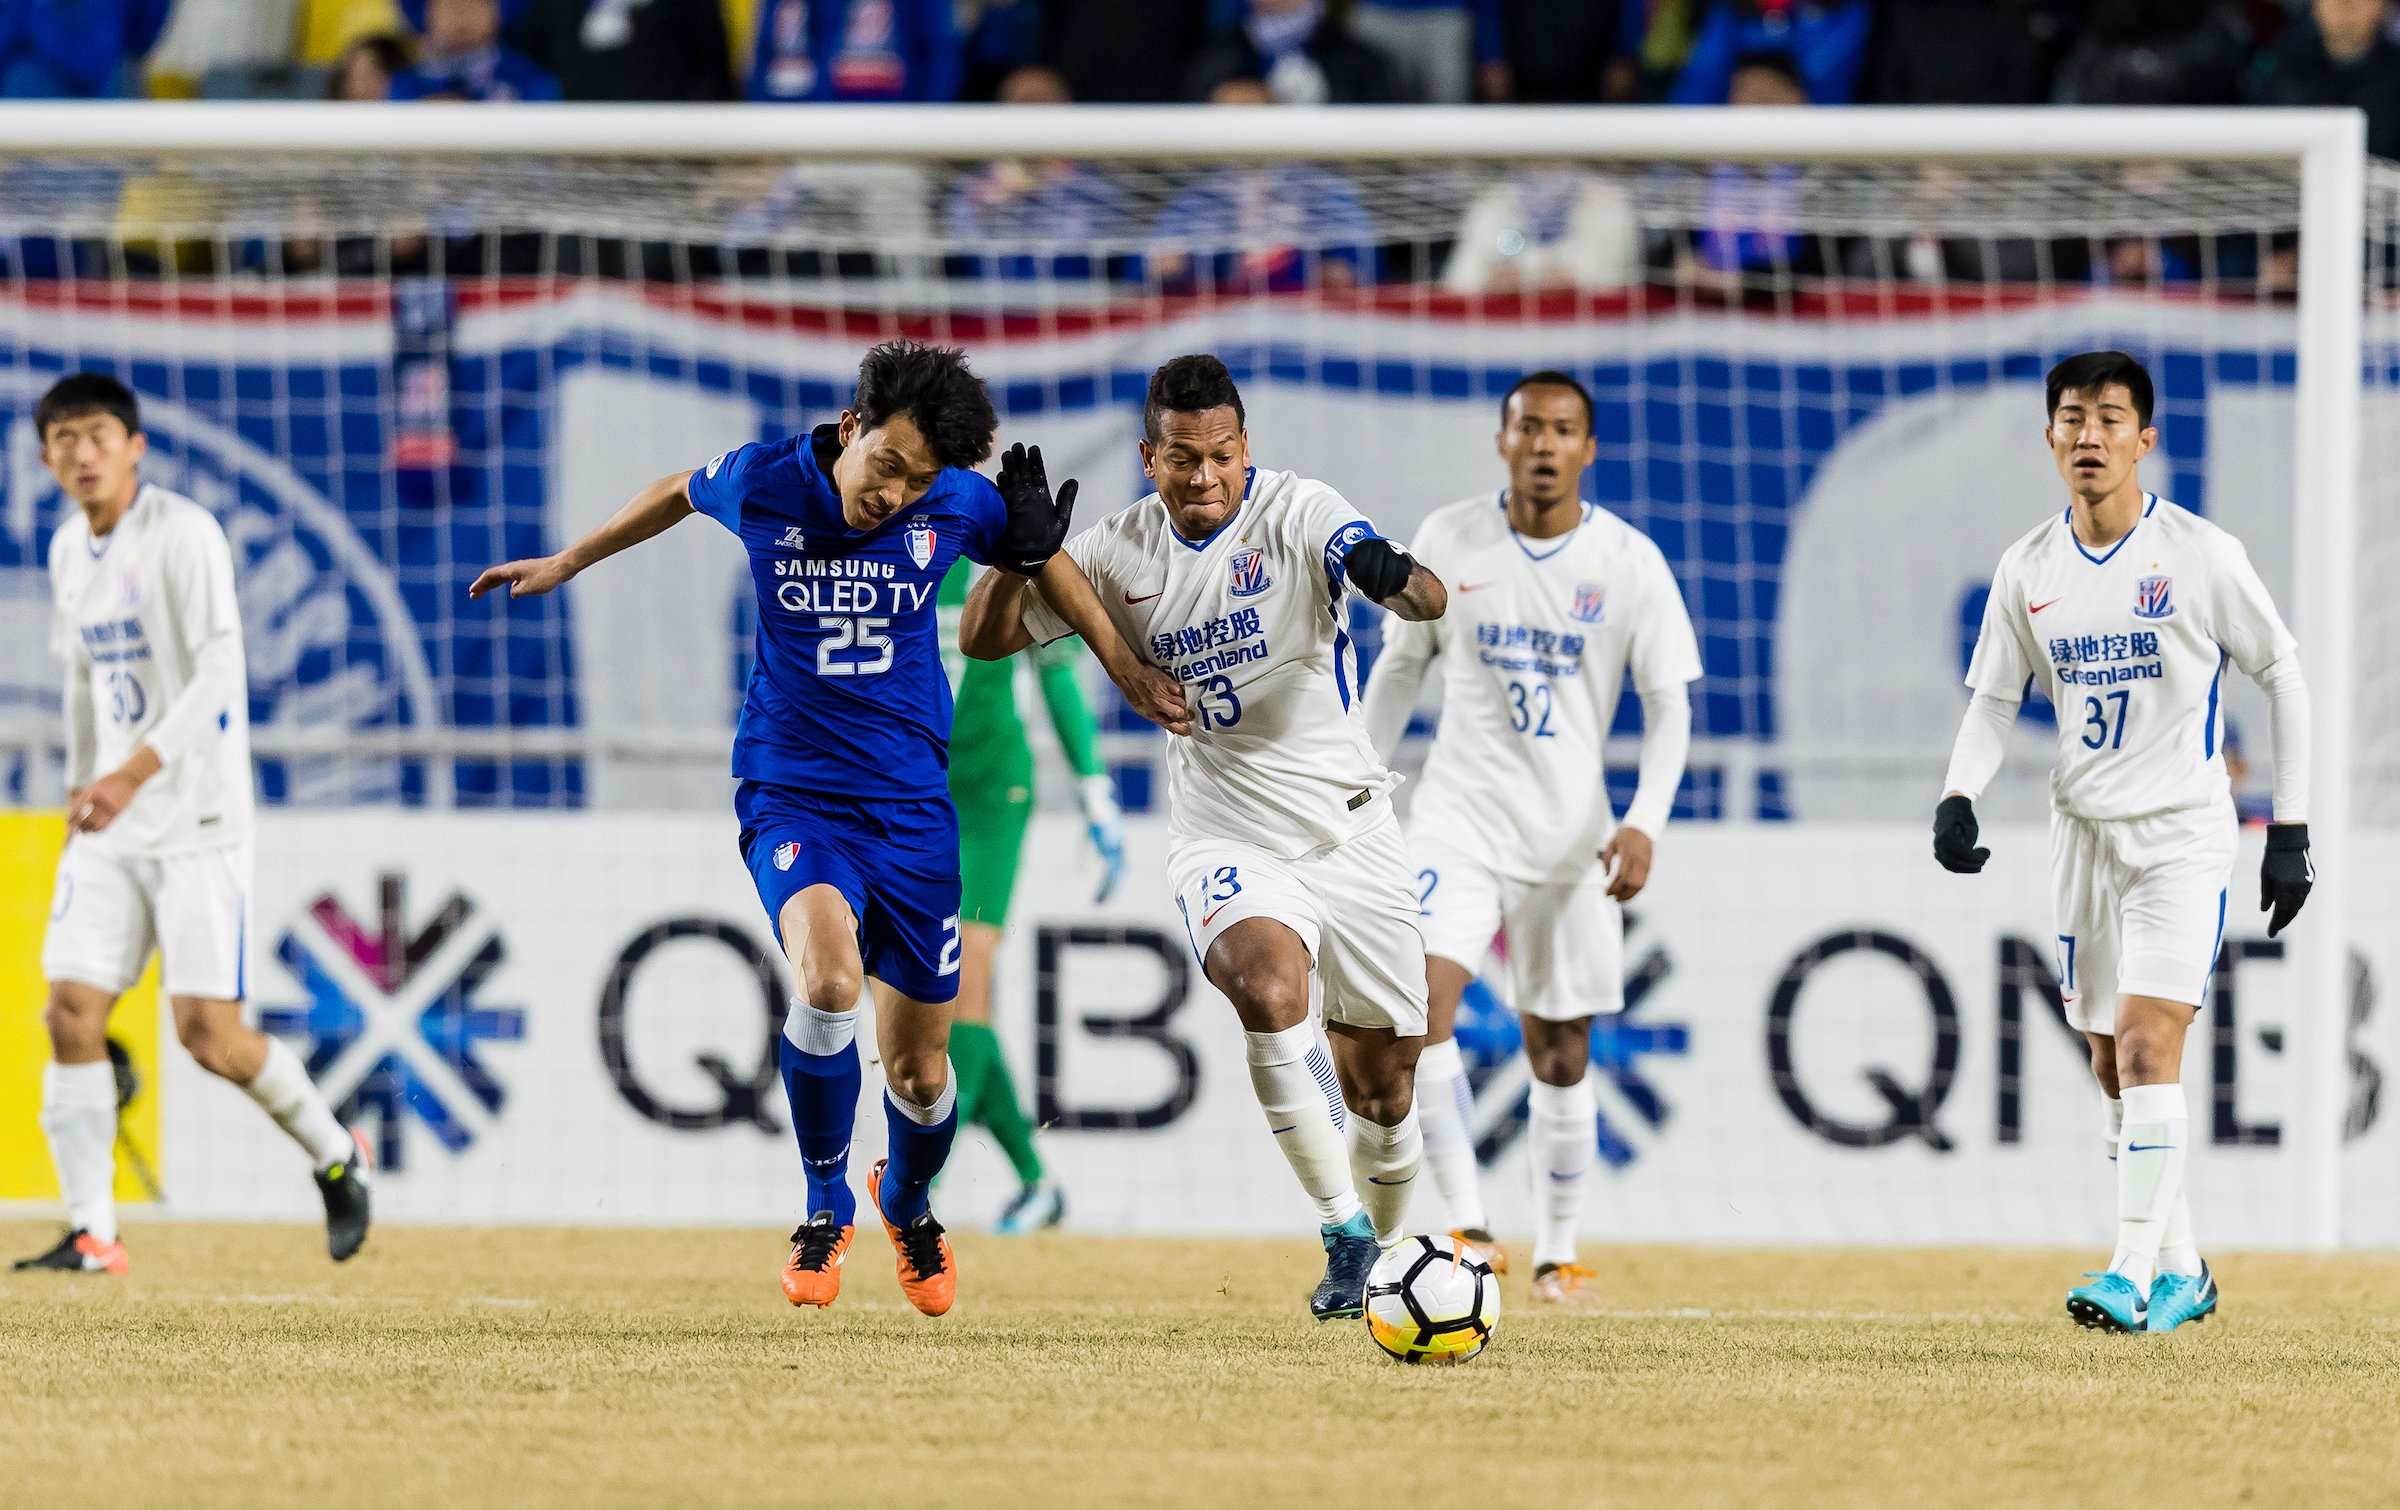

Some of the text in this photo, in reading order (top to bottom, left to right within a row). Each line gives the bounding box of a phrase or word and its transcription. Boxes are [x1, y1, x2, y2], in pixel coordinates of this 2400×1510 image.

[775, 559, 895, 579] SAMSUNG
[777, 580, 933, 614] QLED TV
[817, 616, 895, 676] 25
[1151, 607, 1264, 661] 绿地控股
[2050, 631, 2160, 664] 绿地控股
[108, 671, 147, 723] 30
[2057, 661, 2163, 685] Greenland
[1197, 675, 1242, 730] 13
[1508, 682, 1555, 736] 32
[2081, 690, 2130, 750] 37
[1201, 866, 1242, 913] 13
[938, 907, 962, 976] 2
